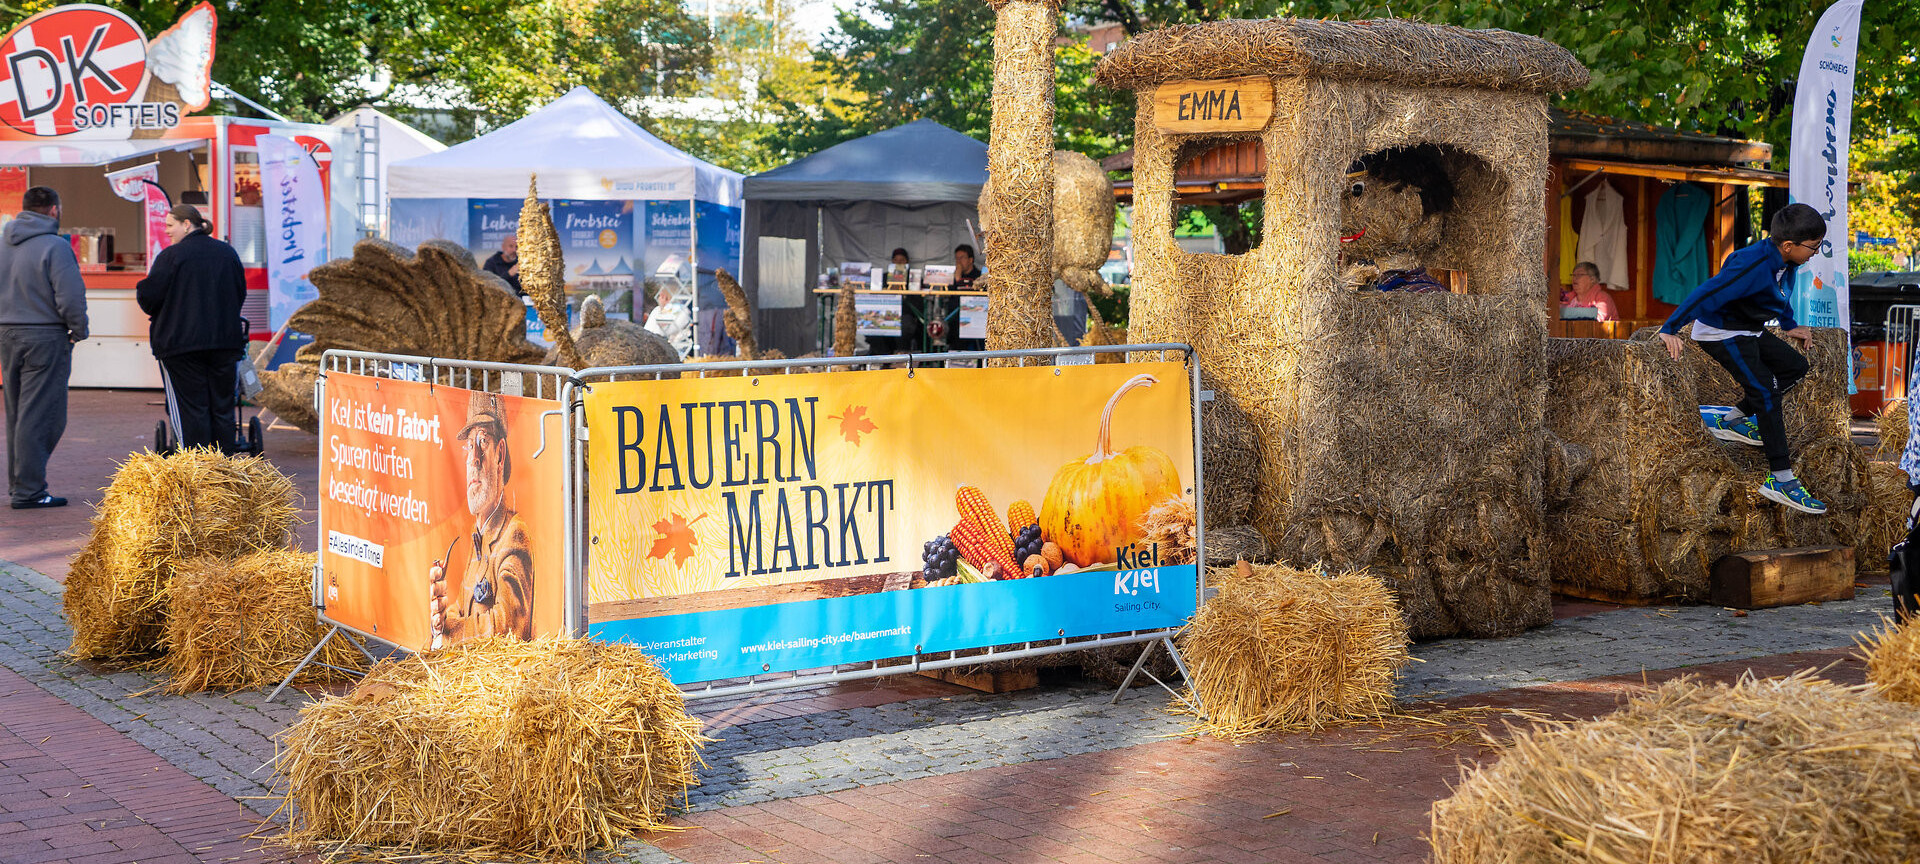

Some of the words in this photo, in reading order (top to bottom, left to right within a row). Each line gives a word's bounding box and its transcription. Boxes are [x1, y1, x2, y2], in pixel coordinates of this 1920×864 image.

[8, 25, 124, 119] DK
[74, 104, 179, 128] SOFTEIS
[1178, 89, 1242, 120] EMMA
[565, 212, 623, 230] Probstei
[651, 211, 691, 228] Schönber
[354, 401, 368, 431] ist
[366, 402, 394, 436] kein
[396, 408, 443, 450] Tatort,
[330, 434, 371, 471] Spuren
[373, 443, 413, 479] dürfen
[612, 397, 819, 494] BAUERN
[329, 471, 378, 517] beseitigt
[380, 489, 430, 524] werden.
[721, 479, 894, 578] MARKT
[1116, 543, 1165, 570] Kiel.
[647, 636, 707, 650] Veranstalter
[740, 625, 912, 654] www.kiel-sailing-city.de/bauernmarkt
[651, 648, 718, 664] iel-Marketing
